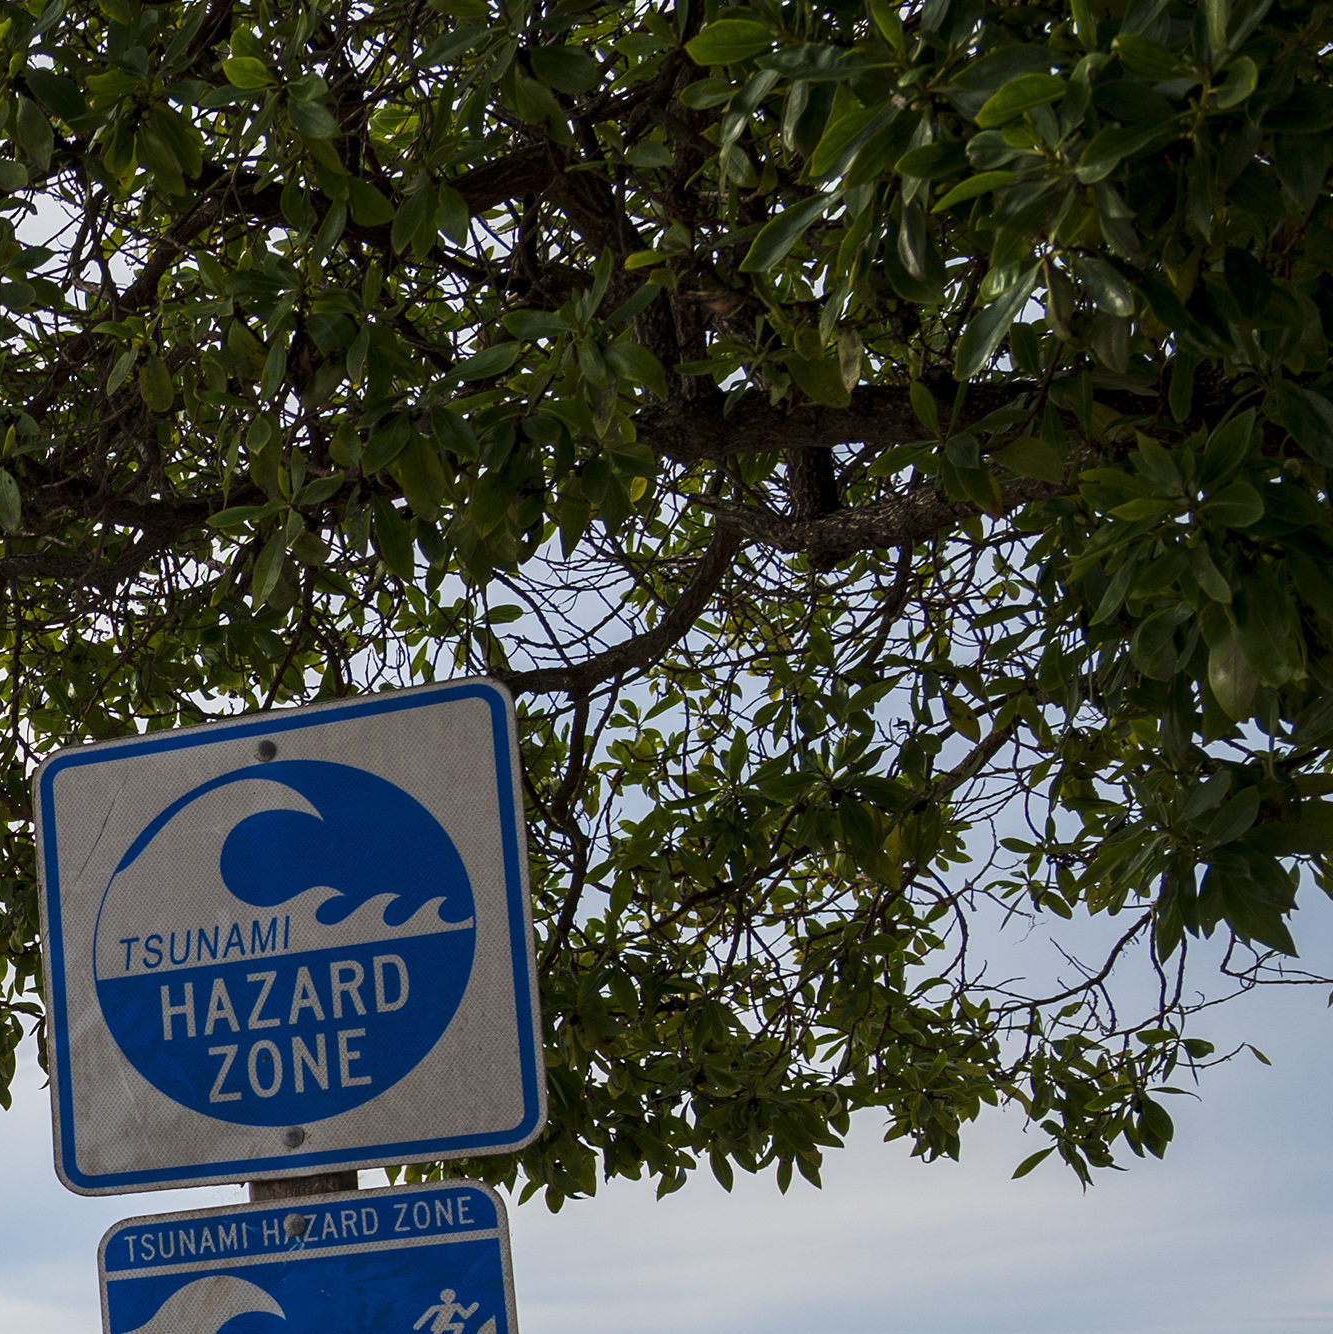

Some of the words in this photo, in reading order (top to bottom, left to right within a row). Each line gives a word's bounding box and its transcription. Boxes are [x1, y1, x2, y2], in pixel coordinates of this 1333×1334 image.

[119, 915, 291, 971] TSUNAMI
[160, 953, 410, 1041] HAZARD
[208, 1028, 372, 1104] ZONE
[124, 1222, 248, 1262] TSUNAMI
[393, 1196, 475, 1232] ZONE
